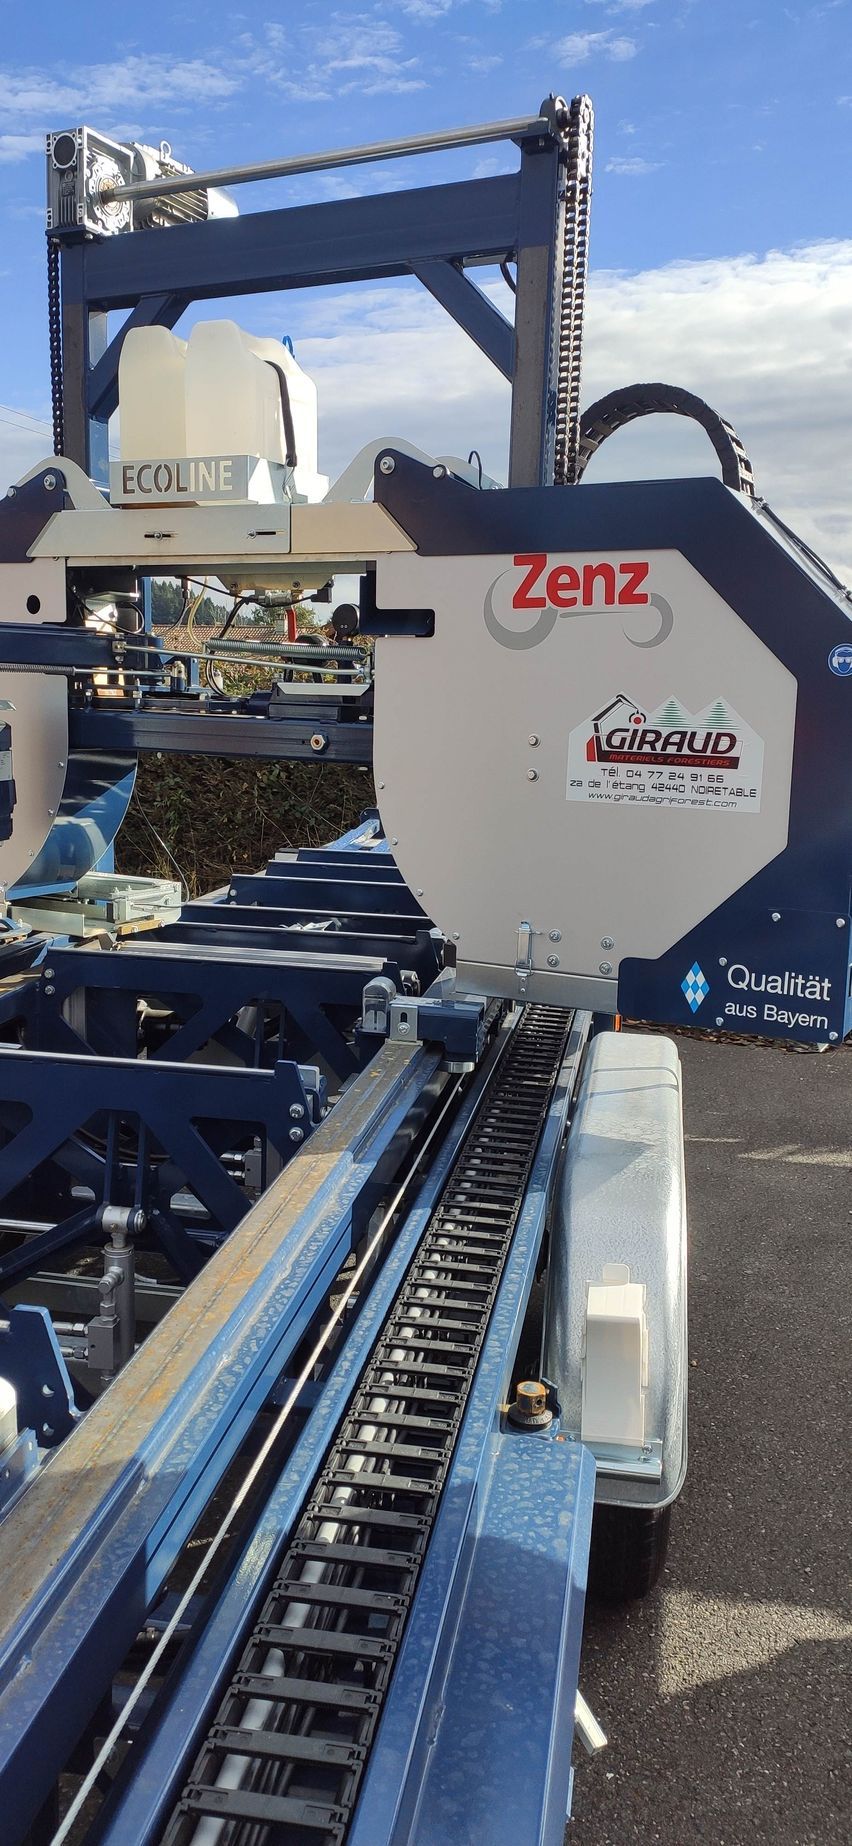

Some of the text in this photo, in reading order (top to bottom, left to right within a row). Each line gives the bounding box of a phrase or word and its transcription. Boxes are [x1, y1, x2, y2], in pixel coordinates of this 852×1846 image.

[122, 460, 233, 495] ECOLINE
[512, 553, 649, 609] Zenz
[605, 728, 737, 755] GIRAUD
[601, 767, 724, 783] Tél. 04 77 24 91 66
[667, 756, 731, 767] FORESTIERS
[569, 779, 757, 798] za de l'étang 42440 NOIRETABLE
[727, 964, 832, 1001] Qualität
[724, 1002, 828, 1029] aus Bayern
